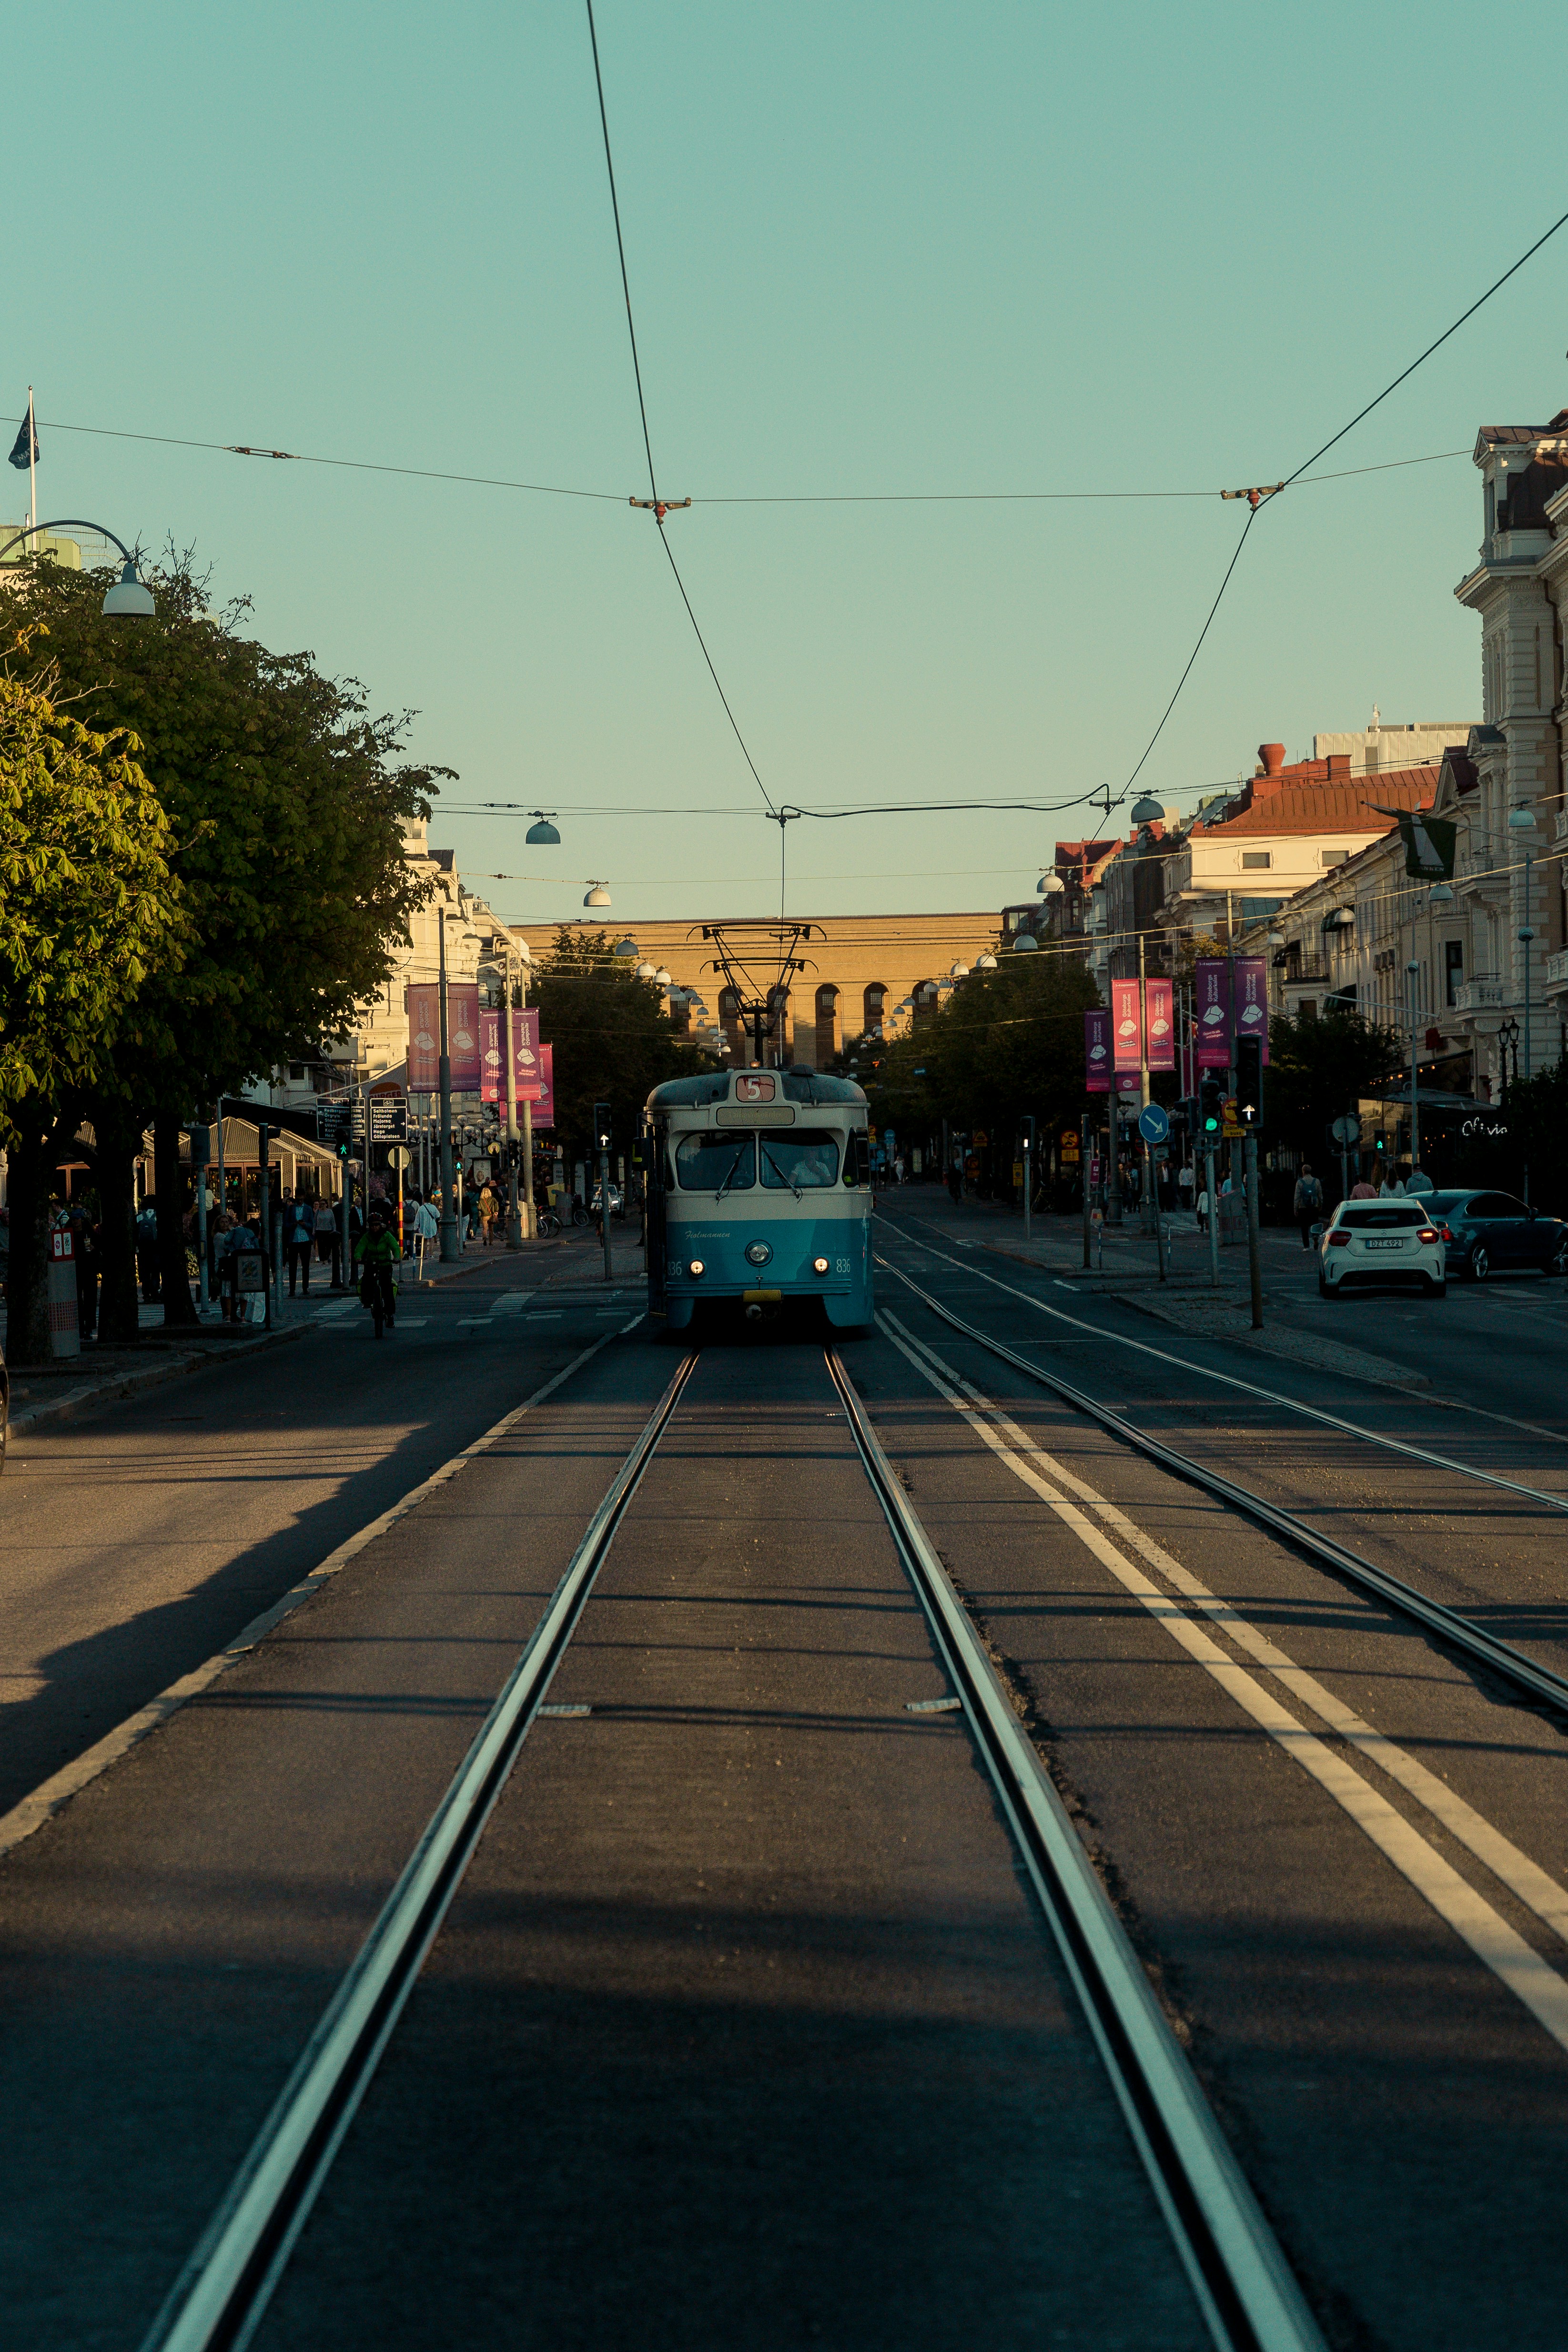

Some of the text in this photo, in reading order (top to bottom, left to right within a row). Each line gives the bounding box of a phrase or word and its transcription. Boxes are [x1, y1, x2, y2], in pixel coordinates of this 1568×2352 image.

[748, 1078, 760, 1100] 5
[1462, 1117, 1508, 1136] Olivia
[685, 1230, 730, 1240] Fiolmannen
[667, 1262, 682, 1276] 836
[836, 1258, 850, 1272] 836
